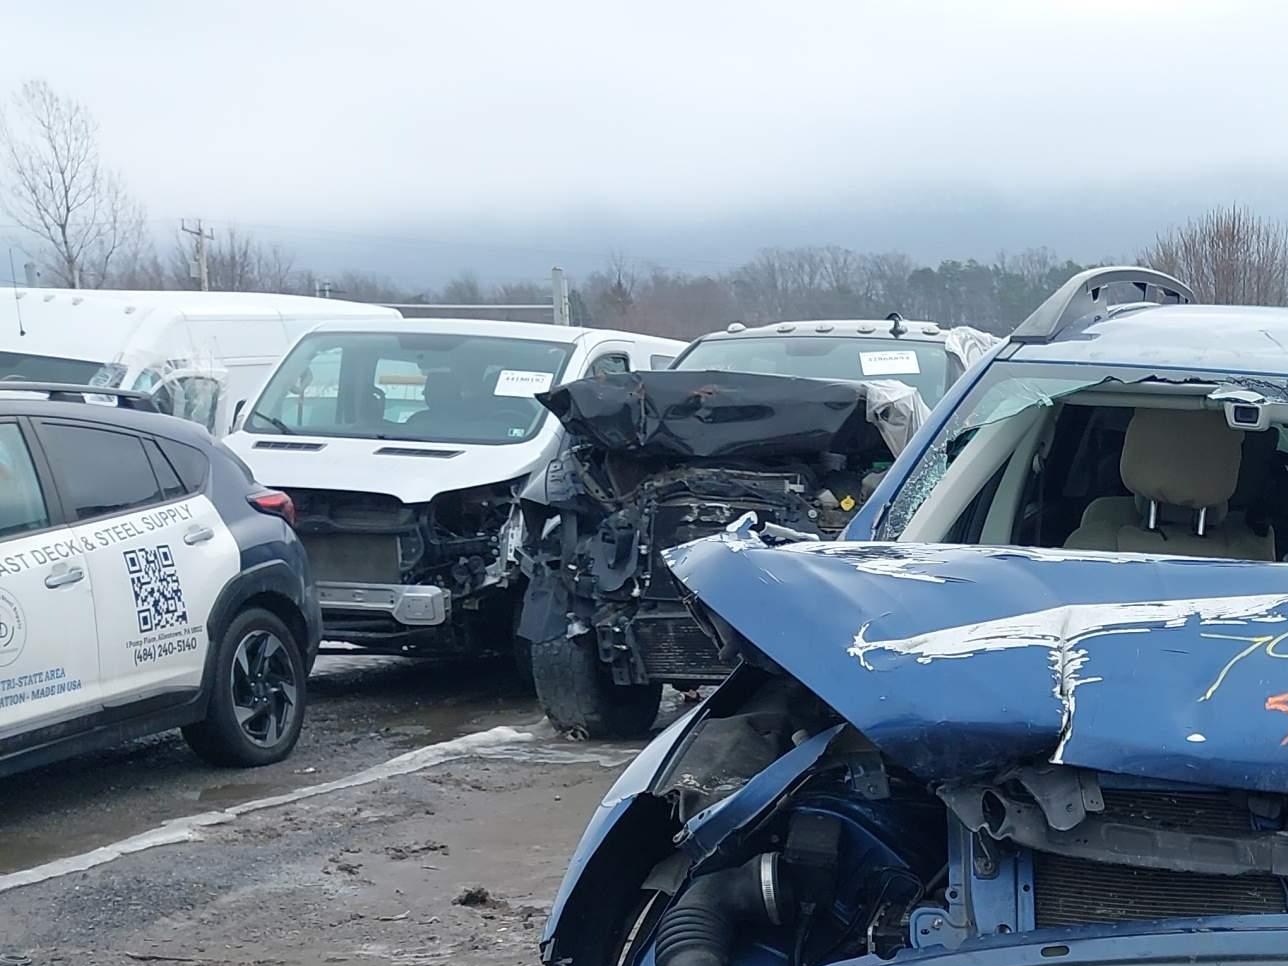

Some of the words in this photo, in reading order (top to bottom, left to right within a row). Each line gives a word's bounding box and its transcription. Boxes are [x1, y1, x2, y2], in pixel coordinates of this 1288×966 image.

[31, 539, 84, 565] DECK
[81, 536, 96, 551] &
[95, 520, 144, 546] STEEL
[141, 504, 194, 530] SUPPLY
[134, 644, 156, 667] (484)
[157, 637, 197, 658] 240-5140
[1, 672, 43, 691] TRI-STATE
[45, 667, 66, 682] AREA
[31, 685, 56, 701] MADE
[56, 682, 66, 694] IN
[66, 679, 82, 692] USA
